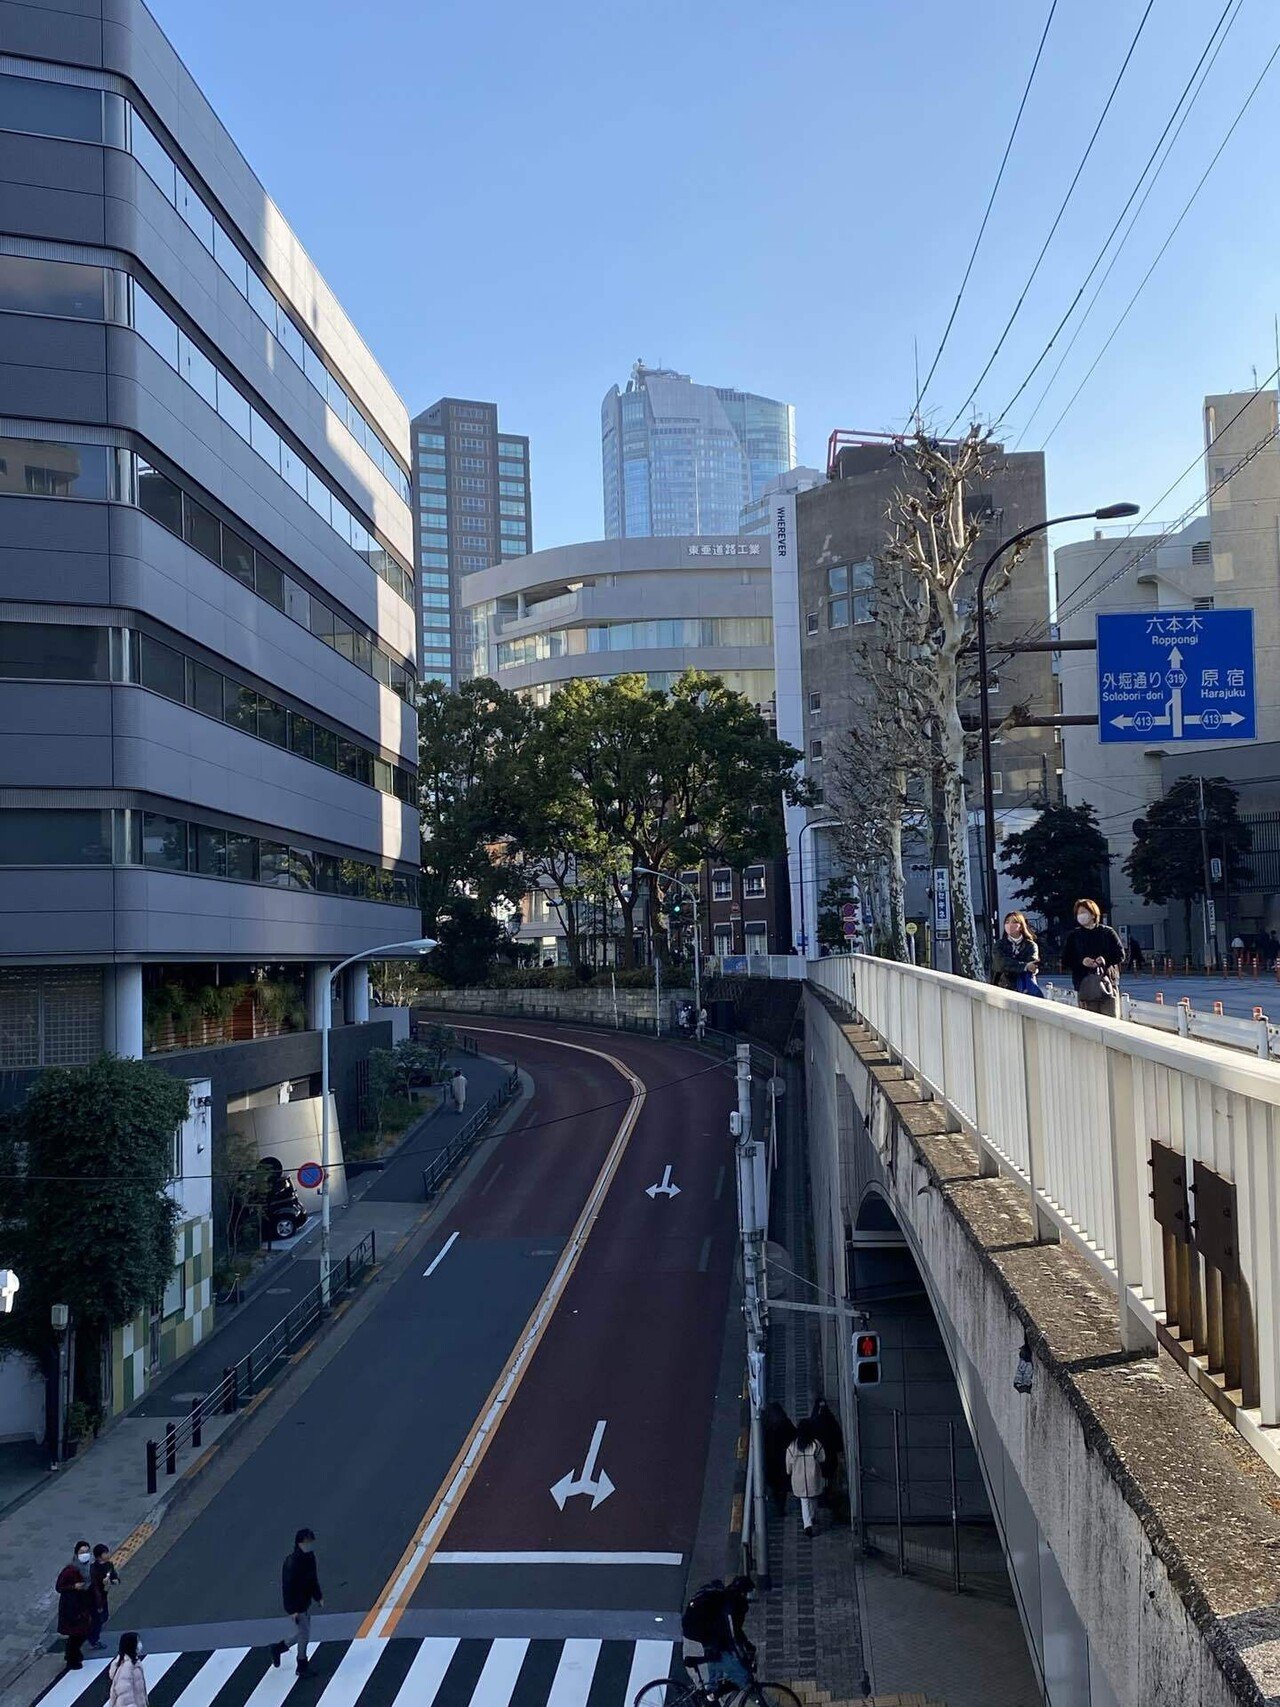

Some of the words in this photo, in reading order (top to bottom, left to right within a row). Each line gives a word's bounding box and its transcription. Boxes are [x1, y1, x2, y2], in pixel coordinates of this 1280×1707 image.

[777, 506, 786, 557] WHEREVER
[1146, 615, 1203, 633] 六本木
[1102, 672, 1161, 690] 外堀通り
[1168, 675, 1184, 684] 319
[1201, 669, 1244, 686] 原宿
[1201, 689, 1246, 699] Harajuku
[1135, 716, 1151, 726] 413
[1203, 714, 1219, 724] 413
